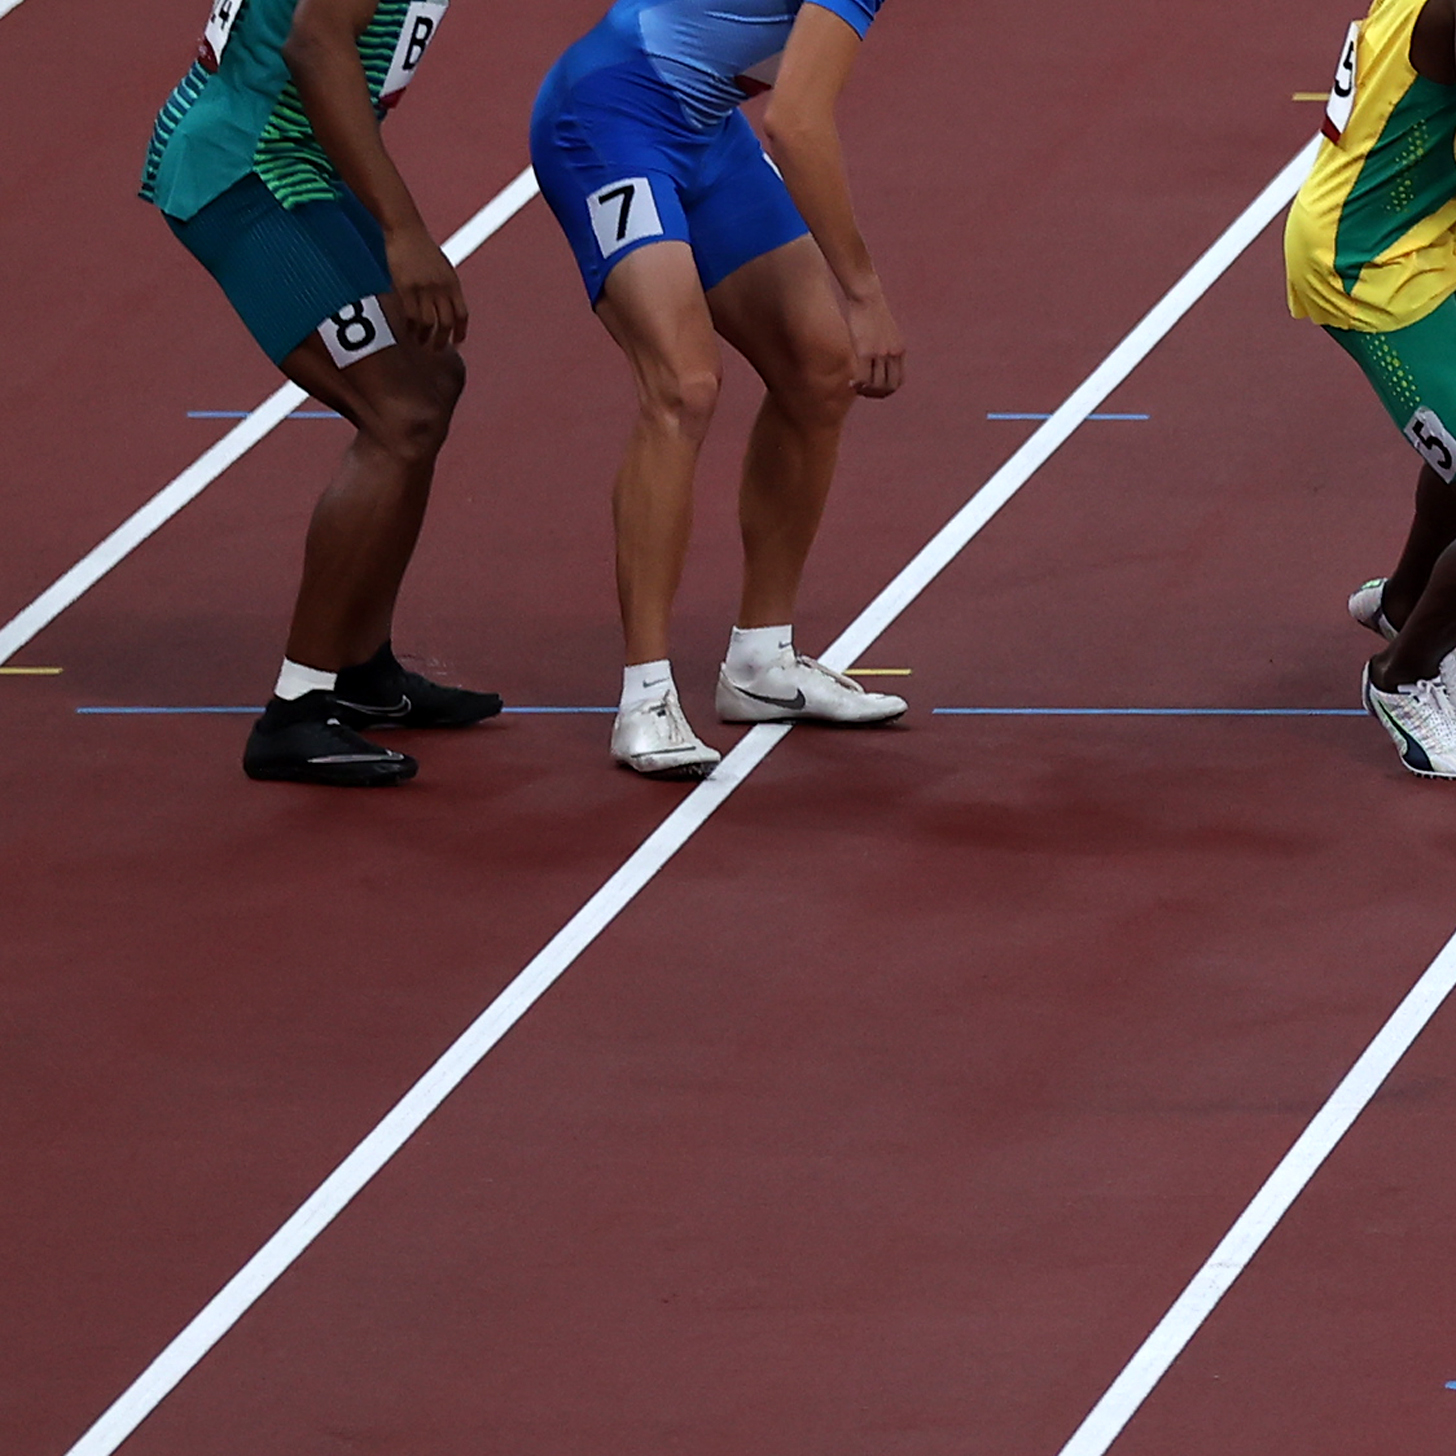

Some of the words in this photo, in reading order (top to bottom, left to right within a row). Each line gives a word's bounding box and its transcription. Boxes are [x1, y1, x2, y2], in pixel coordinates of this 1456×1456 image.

[598, 184, 635, 241] 7
[330, 300, 376, 351] 8
[1412, 419, 1453, 470] 5
